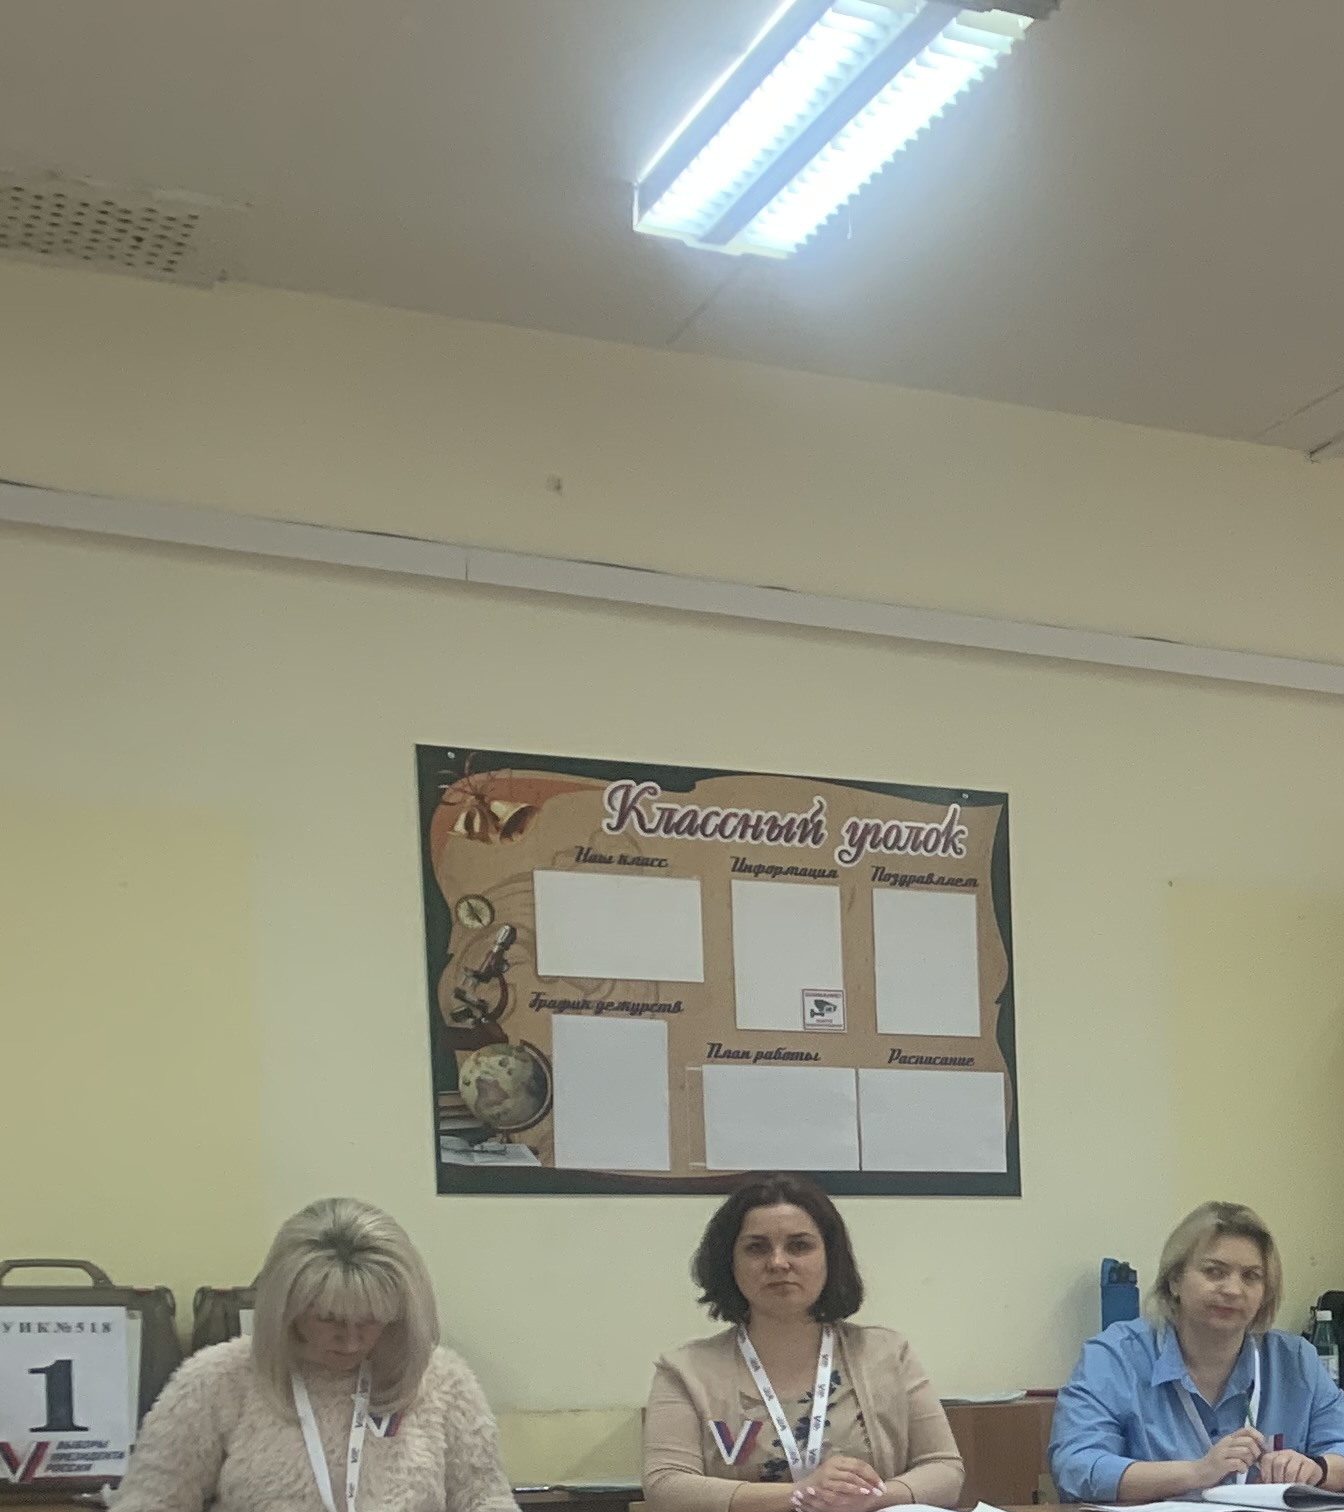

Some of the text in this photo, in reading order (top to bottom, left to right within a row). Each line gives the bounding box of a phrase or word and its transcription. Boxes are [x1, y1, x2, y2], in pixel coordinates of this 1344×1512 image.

[605, 782, 966, 864] Классный уголок
[575, 846, 668, 867] Наш класс
[730, 856, 839, 879] Информация
[706, 1042, 821, 1064] План работы
[887, 1048, 976, 1067] Расписание
[28, 1359, 89, 1433] 1
